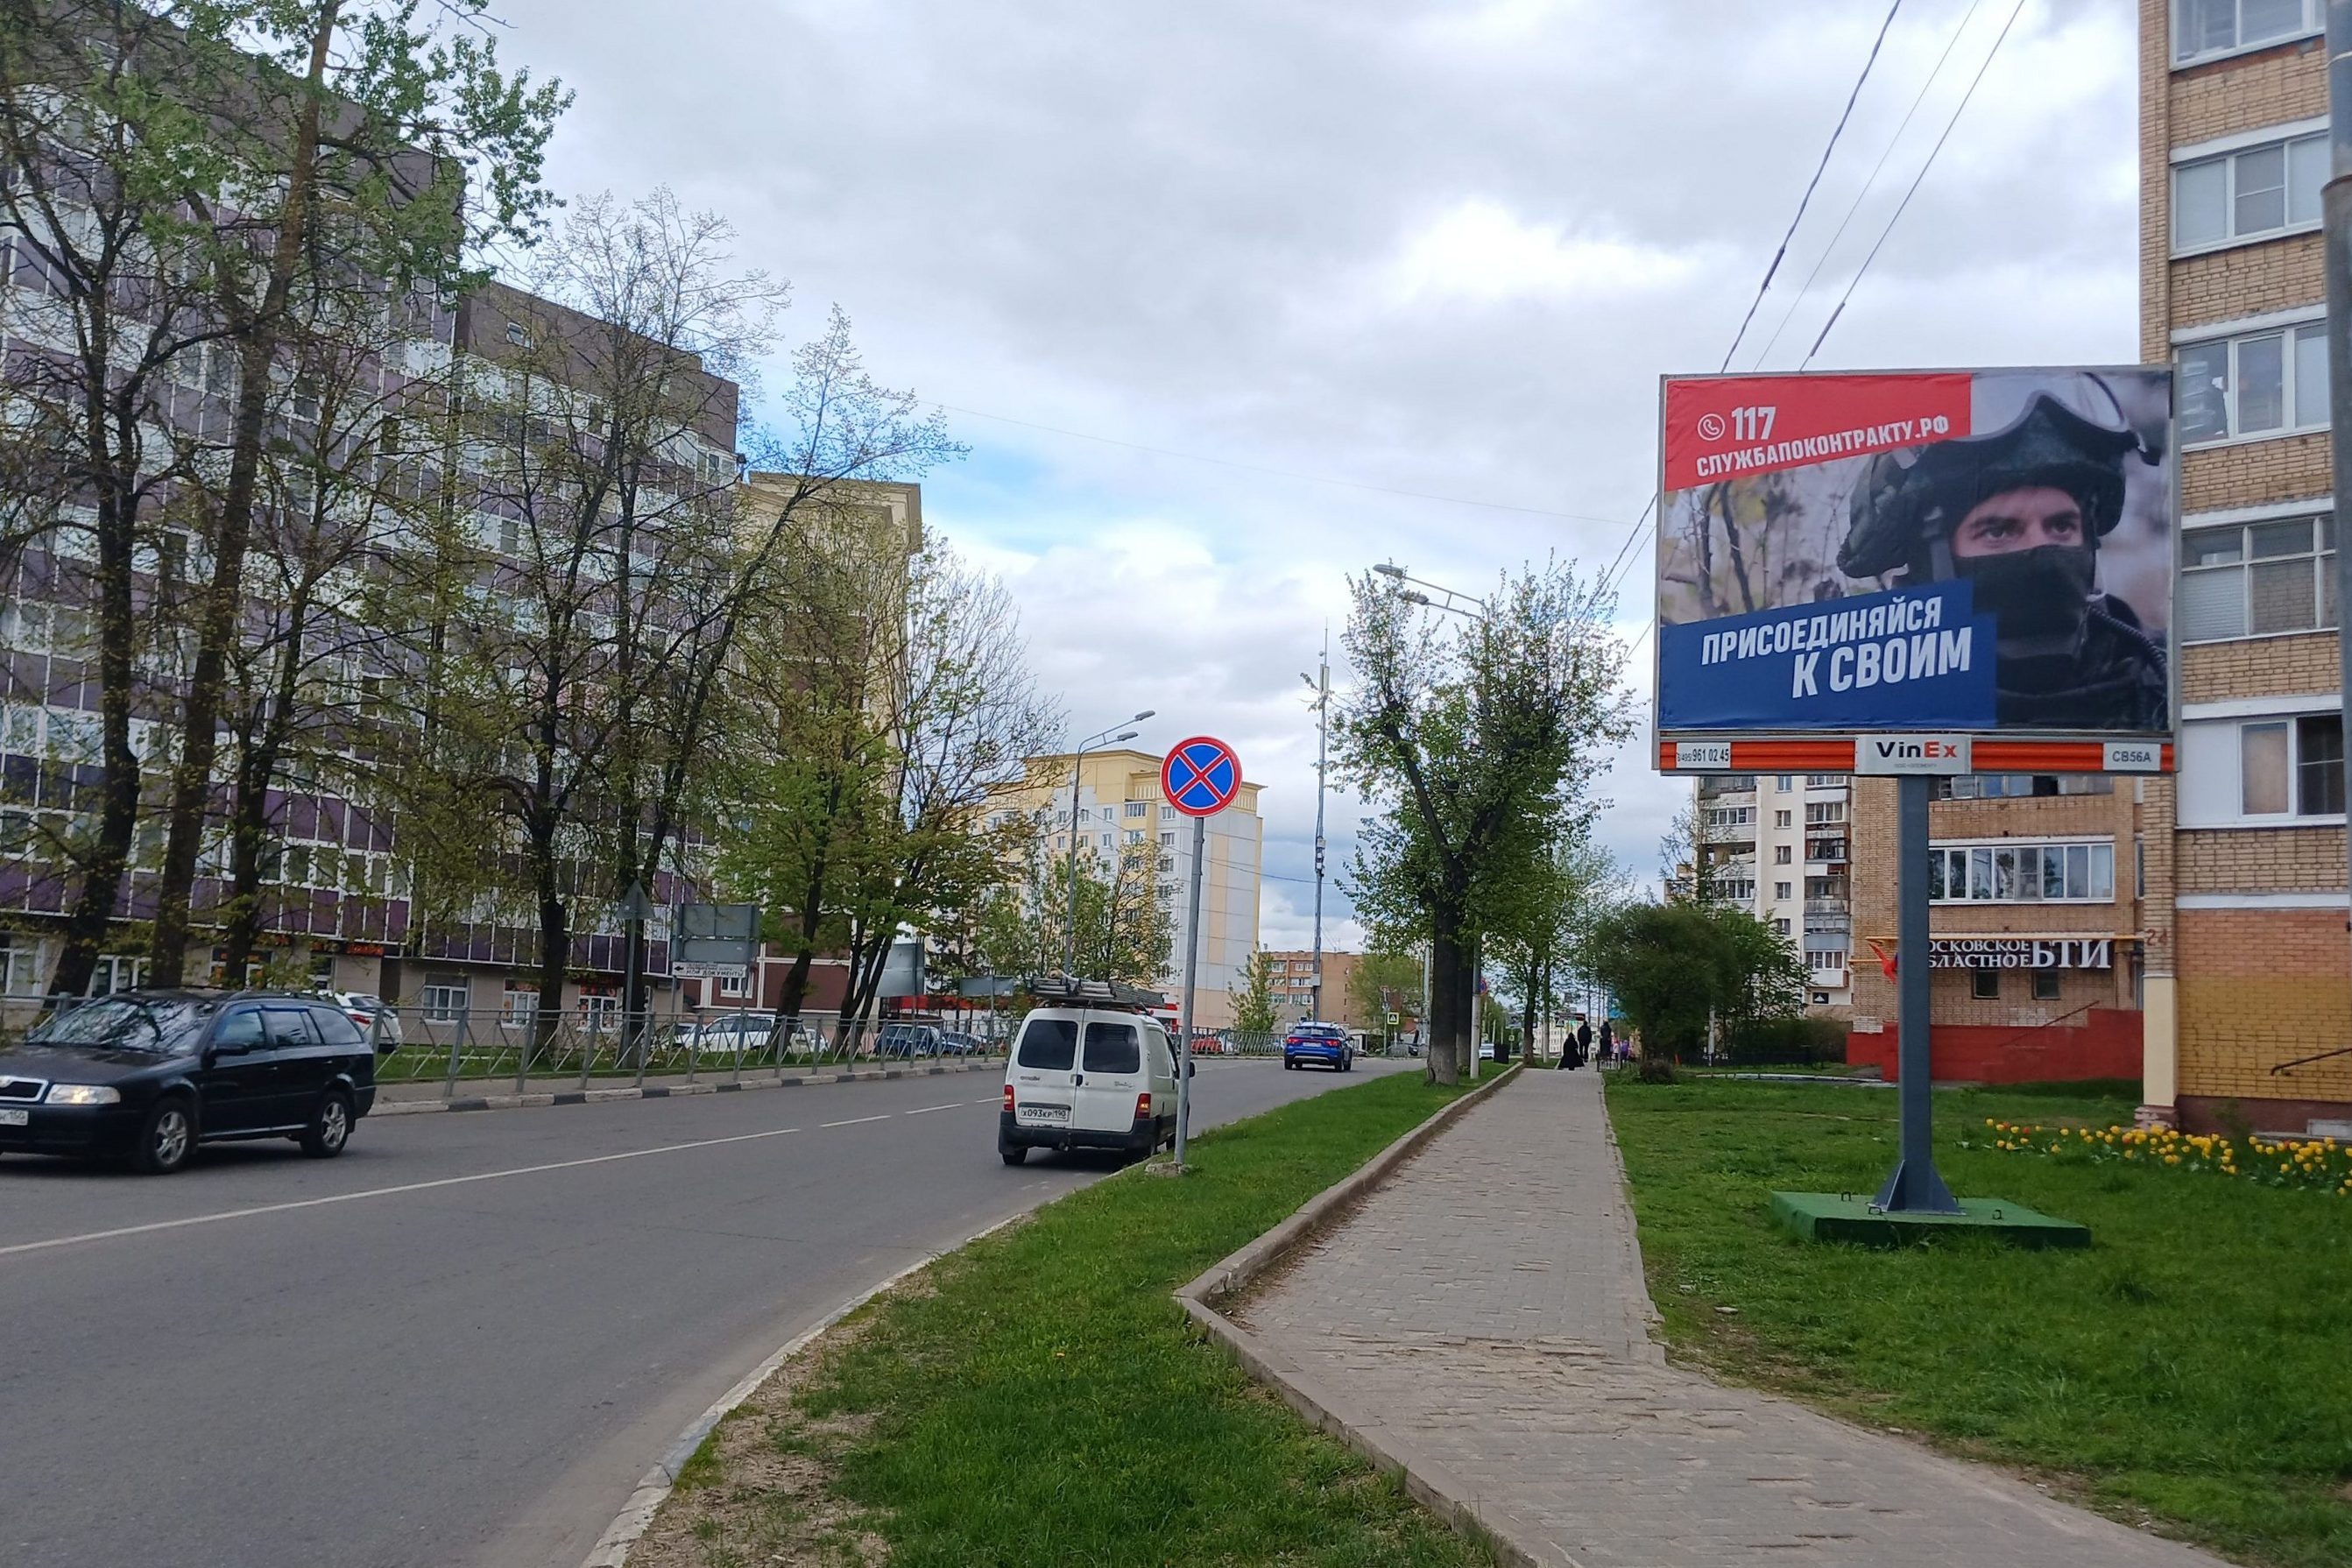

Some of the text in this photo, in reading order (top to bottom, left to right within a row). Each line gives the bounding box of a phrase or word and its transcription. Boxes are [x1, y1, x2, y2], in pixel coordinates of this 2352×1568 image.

[1731, 406, 1776, 441] 117
[1697, 415, 1949, 477] СЛУЖБАПОКОНТРАКТУ.РФ
[1701, 596, 1942, 665] ПРИСОЕДИНЯЙСЯ
[1792, 626, 1972, 698] К СВОИМ
[1692, 748, 1706, 762] 961
[1708, 748, 1718, 762] 02
[1720, 748, 1729, 762] 45
[1875, 741, 1957, 758] VinEx
[1929, 940, 2031, 952] ОСКОВСКОЕ
[1929, 953, 2031, 968] БЛАСТНОЕ
[2030, 939, 2111, 968] БТИ
